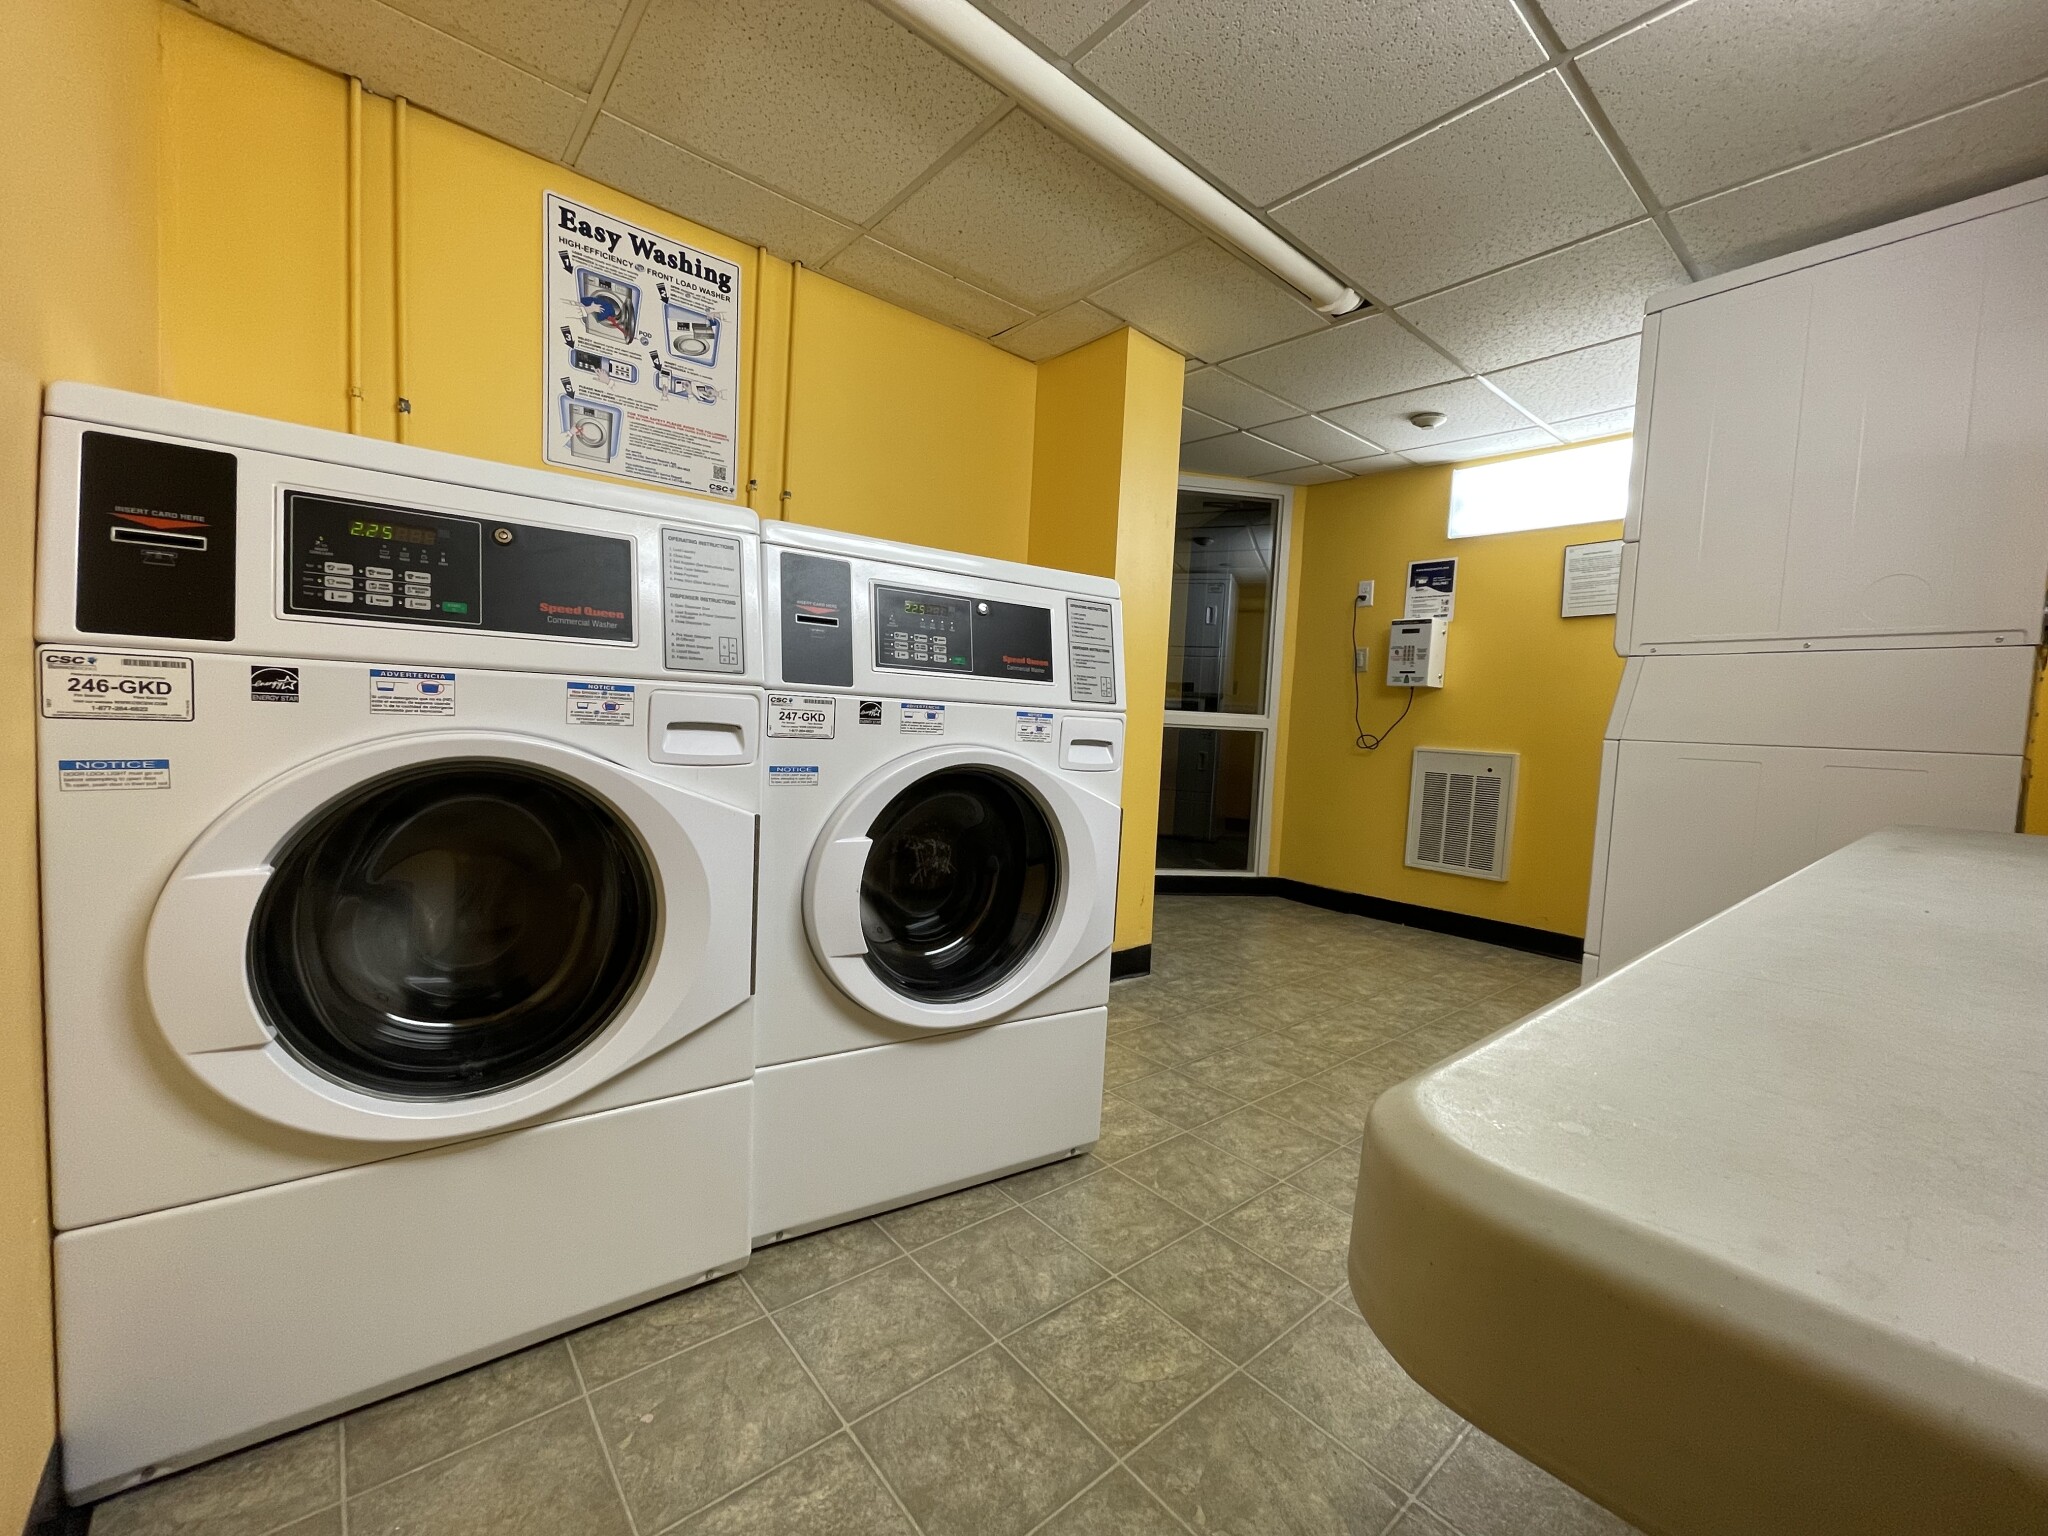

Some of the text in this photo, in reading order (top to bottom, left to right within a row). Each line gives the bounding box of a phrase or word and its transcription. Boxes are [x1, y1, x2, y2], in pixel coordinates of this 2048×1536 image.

[558, 205, 622, 253] Easy
[628, 232, 732, 294] Washing
[558, 236, 634, 269] HIGH-EFFICIENCY
[647, 268, 674, 287] FRONT
[675, 278, 698, 291] LOAD
[699, 285, 732, 303] WASHER
[565, 384, 572, 392] 5
[709, 483, 729, 492] CSC
[115, 505, 205, 522] INSERT CARD HERE
[351, 522, 393, 540] 2.25
[540, 602, 625, 619] Speed Queen
[547, 615, 618, 628] Commercial Washer
[46, 655, 85, 664] CSC
[380, 671, 446, 679] ADVERTENCIA
[67, 677, 172, 694] 246-GKD
[779, 711, 826, 722] 247-GKD
[76, 761, 155, 769] NOTICE
